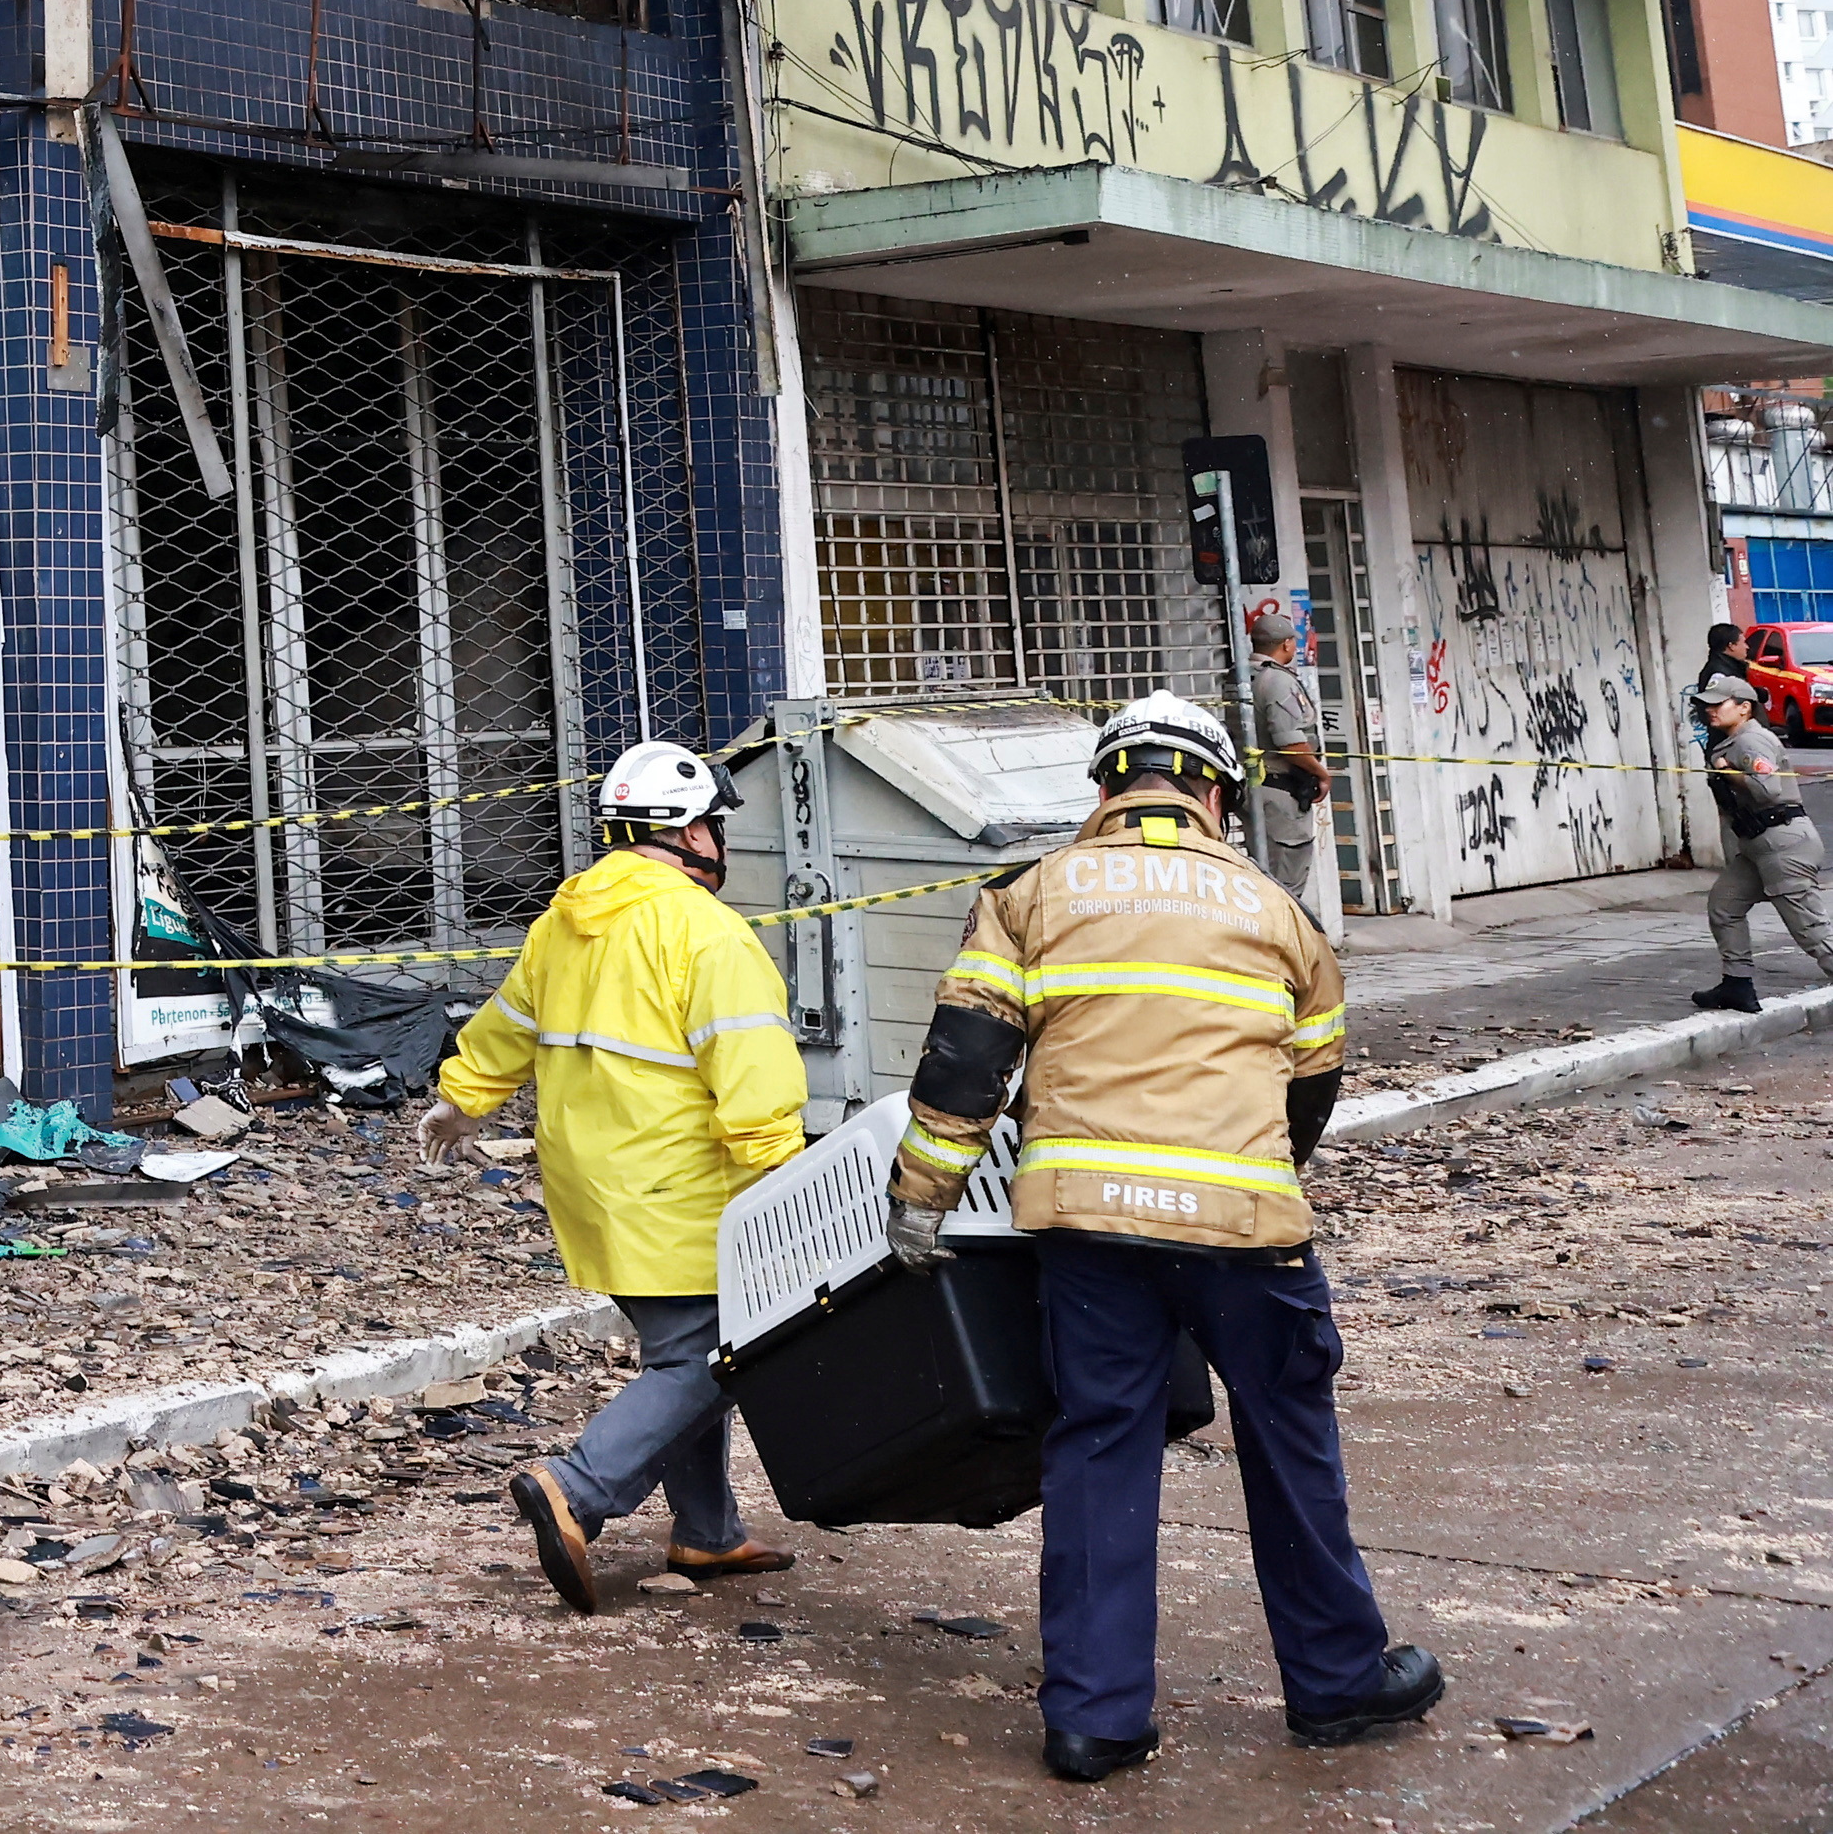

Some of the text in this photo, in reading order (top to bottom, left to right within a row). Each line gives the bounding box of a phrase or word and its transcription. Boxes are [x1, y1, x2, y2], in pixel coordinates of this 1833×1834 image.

[1108, 715, 1137, 736] PIRES
[616, 785, 629, 797] 02
[662, 786, 689, 796] EVANDRO
[1064, 852, 1263, 914] CBMRS
[1068, 898, 1261, 936] CORPO DE BOMBEIROS MILITAR
[151, 1007, 208, 1026] Partenon
[1102, 1182, 1199, 1214] PIRES
